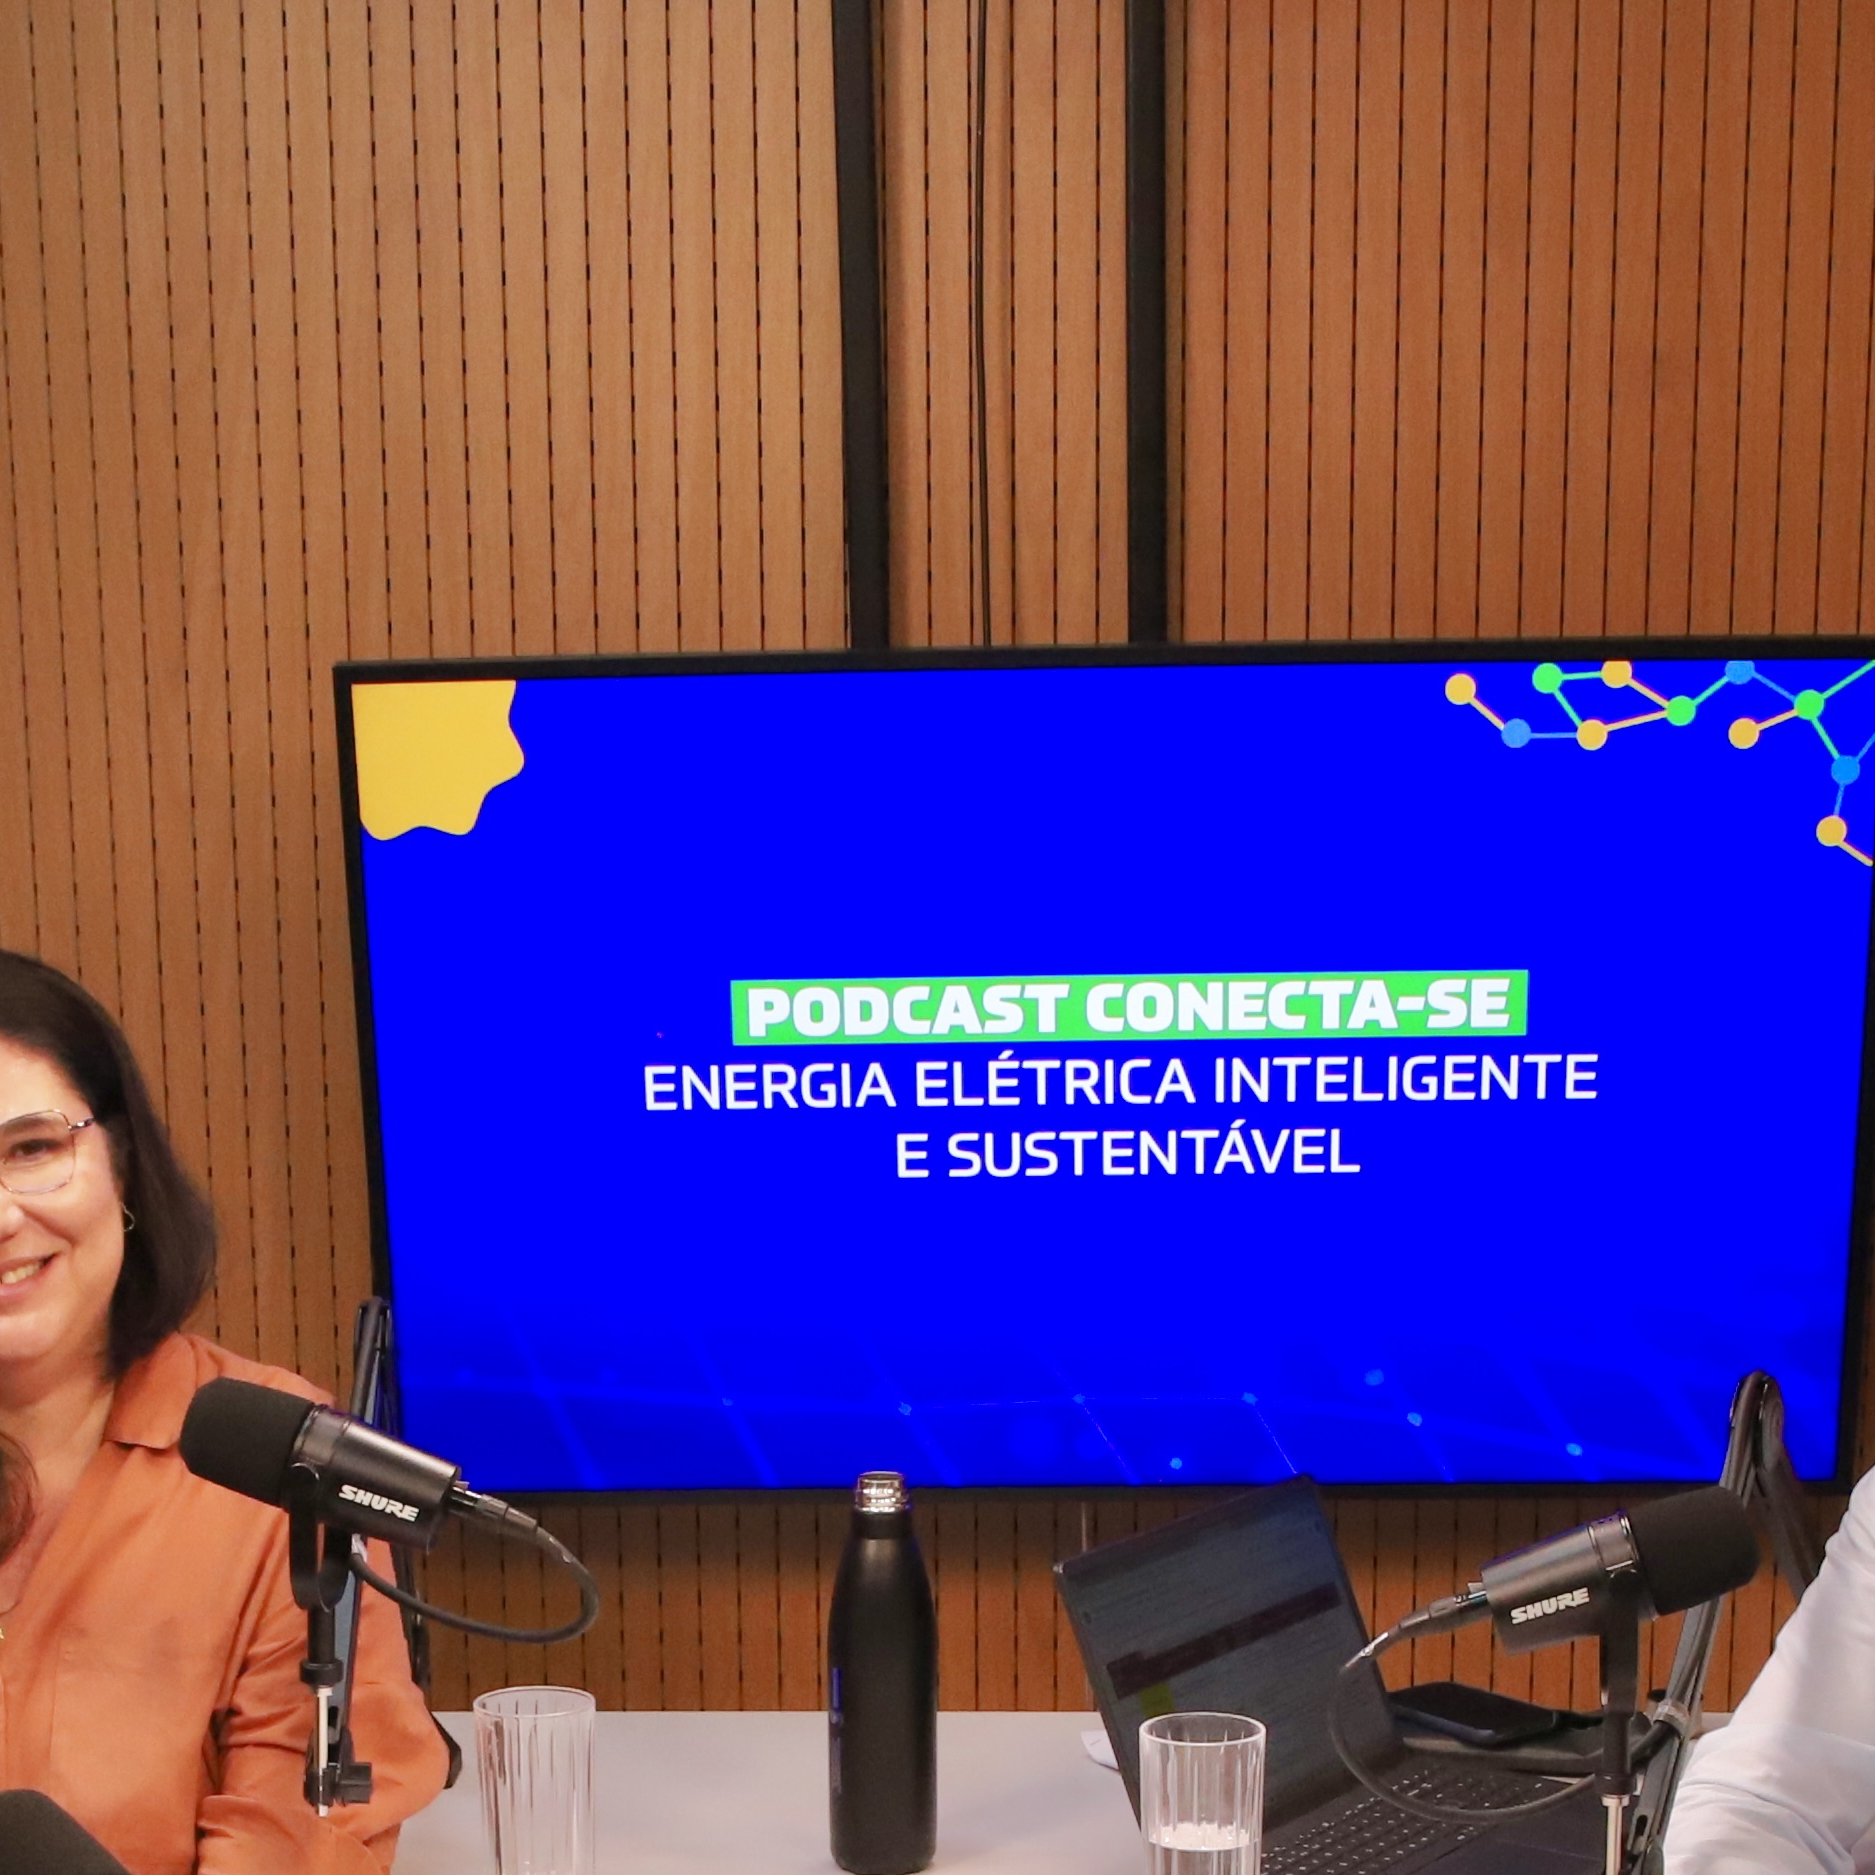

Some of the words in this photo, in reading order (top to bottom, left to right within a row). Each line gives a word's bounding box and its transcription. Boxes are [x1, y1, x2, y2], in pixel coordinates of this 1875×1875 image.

[747, 984, 1071, 1037] PODCAST
[1086, 978, 1511, 1033] CONECTA-SE
[644, 1063, 897, 1111] ENERGIA
[916, 1051, 1196, 1107] ELÉTRICA
[1215, 1055, 1599, 1103] INTELIGENTE
[896, 1134, 929, 1178] E
[948, 1120, 1361, 1177] SUSTENTÁVEL
[338, 1485, 419, 1522] SHURE
[1510, 1587, 1590, 1626] SHURE
